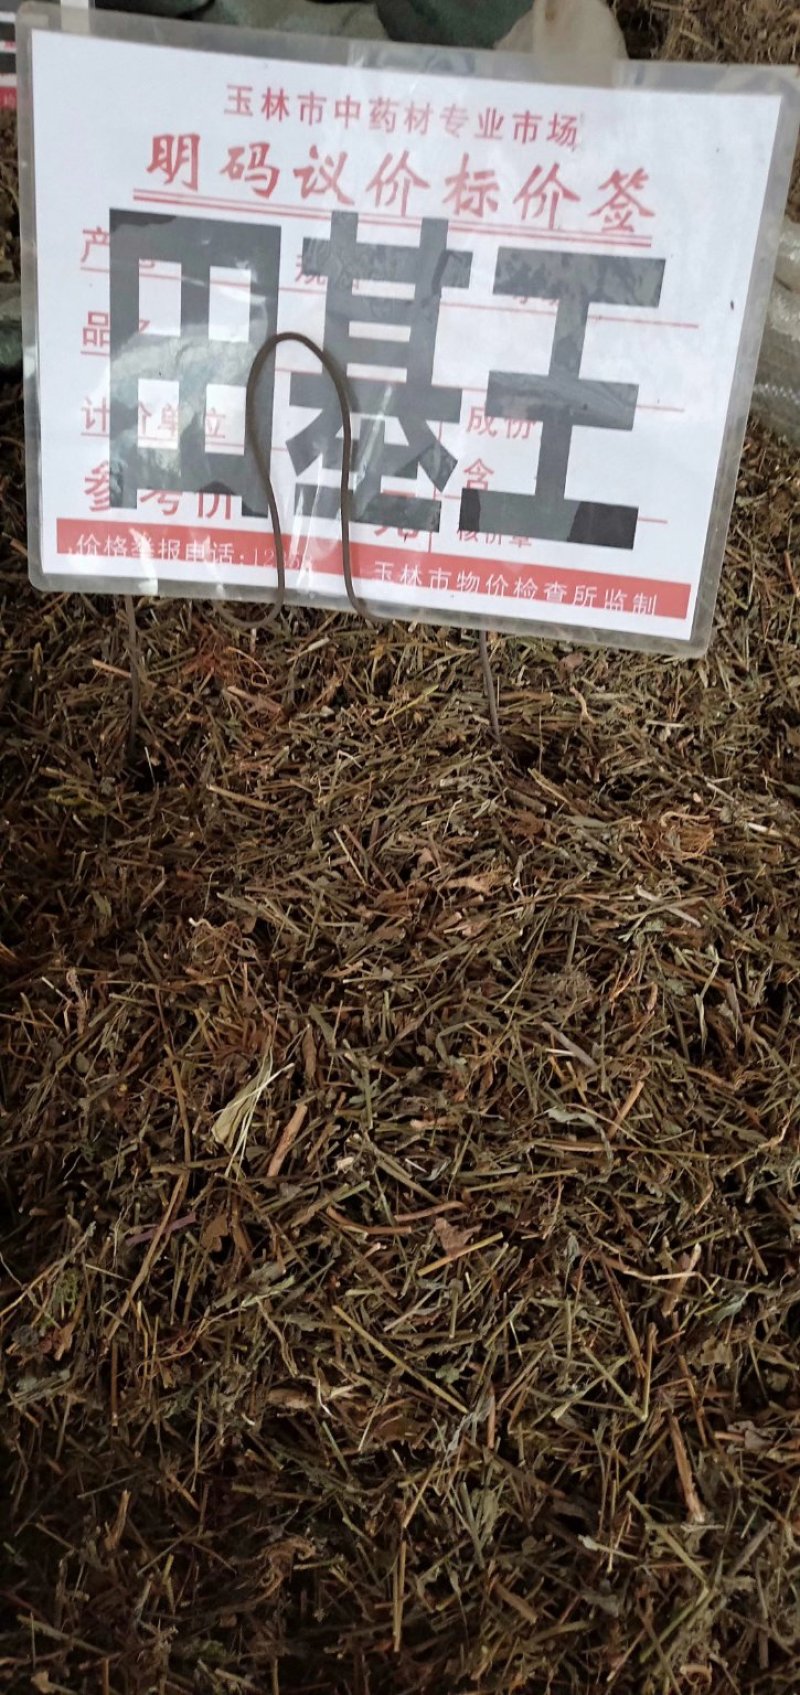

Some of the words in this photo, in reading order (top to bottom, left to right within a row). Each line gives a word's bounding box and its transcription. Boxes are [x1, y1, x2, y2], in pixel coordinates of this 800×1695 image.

[225, 83, 579, 150] 玉林市中药材专业市场
[146, 132, 656, 232] 明码议价标价签
[109, 208, 666, 550] 田基王
[374, 560, 657, 616] 玉林市物价检查所监制
